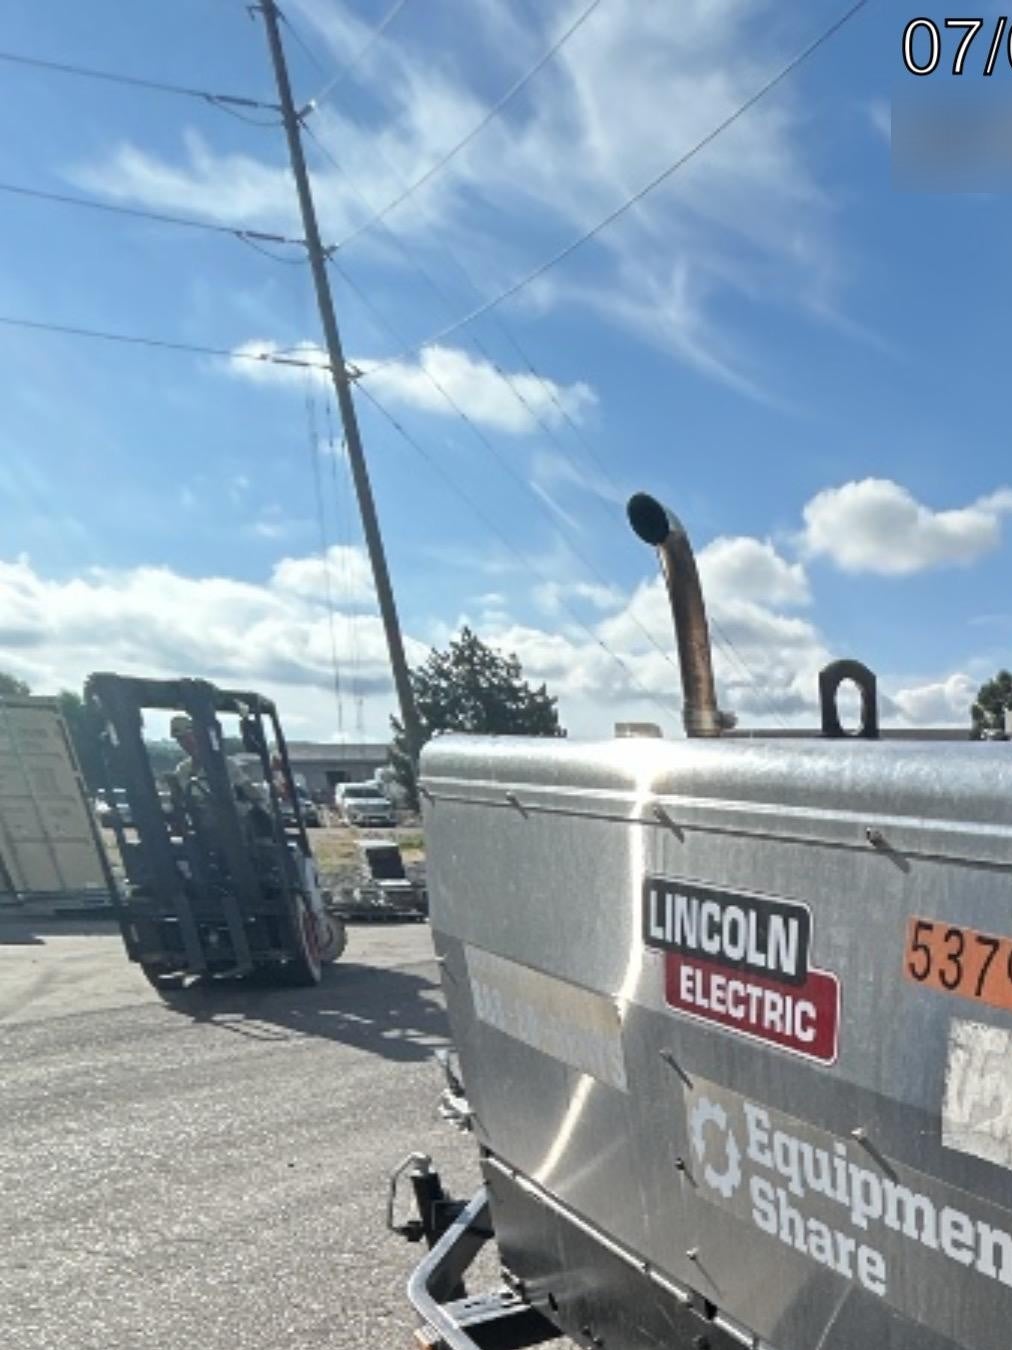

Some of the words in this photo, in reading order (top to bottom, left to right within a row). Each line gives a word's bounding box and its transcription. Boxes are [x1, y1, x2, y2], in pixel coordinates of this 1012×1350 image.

[649, 889, 799, 976] LINCOLN
[680, 965, 816, 1043] ELECTRIC
[750, 1176, 887, 1297] Share
